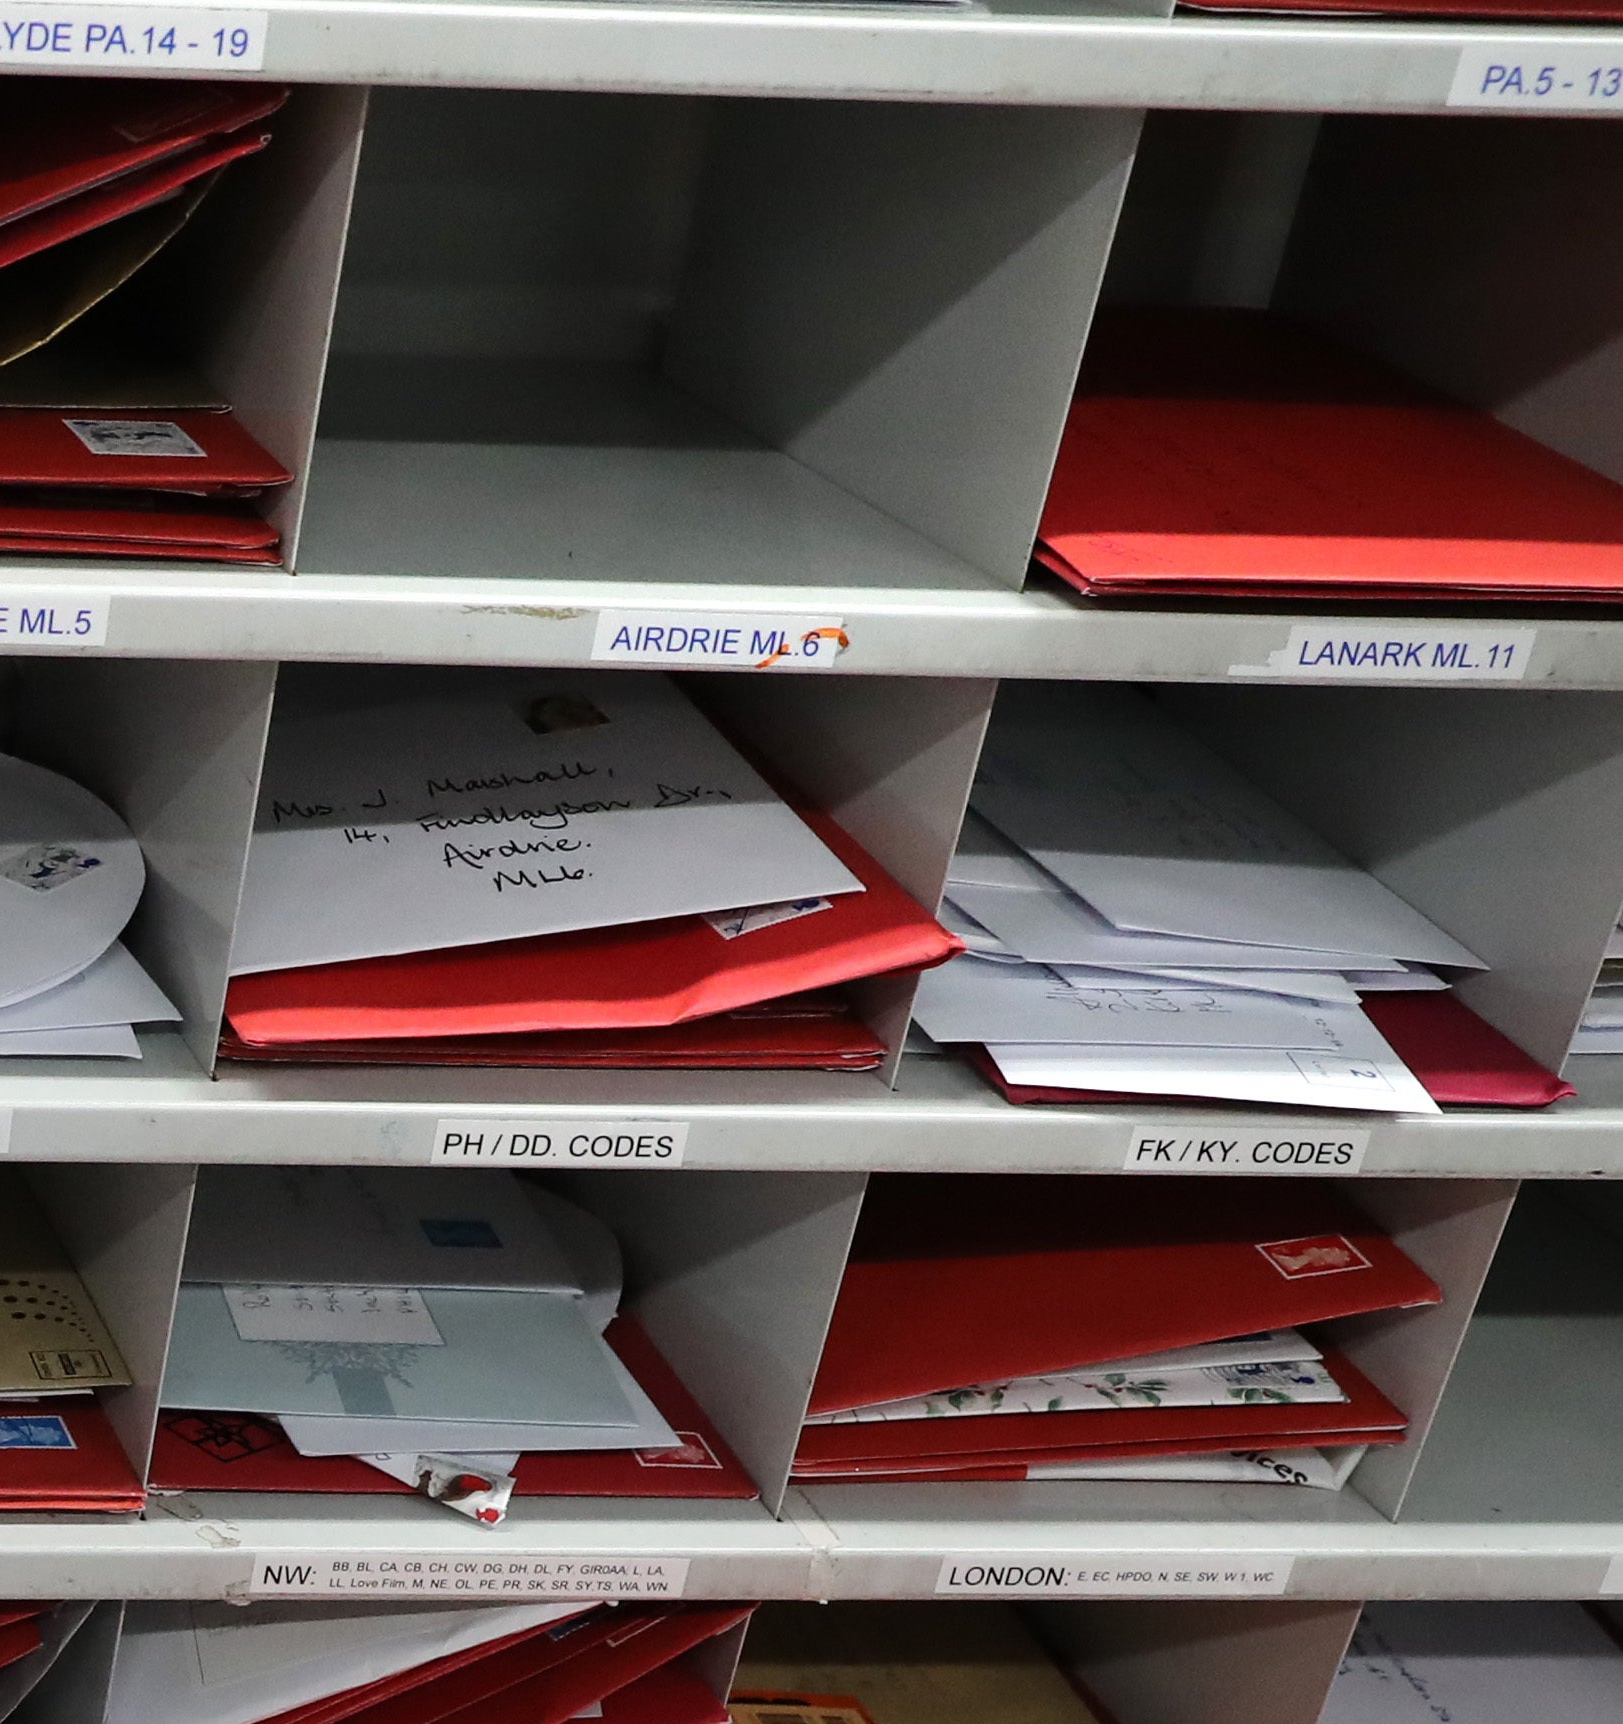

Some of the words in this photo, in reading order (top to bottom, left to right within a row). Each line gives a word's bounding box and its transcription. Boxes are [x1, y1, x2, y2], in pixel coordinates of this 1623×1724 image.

[85, 24, 176, 55] PA.14
[213, 28, 249, 58] 19
[1481, 65, 1556, 96] PA.5
[1589, 67, 1623, 97] 13
[19, 608, 91, 635] ML.5
[610, 626, 742, 654] AIRDRIE
[749, 628, 820, 657] ML.6
[1298, 640, 1426, 668] LANARK
[1430, 643, 1516, 668] ML.11
[443, 1133, 484, 1155] PH
[509, 1134, 556, 1157] DD.
[569, 1134, 674, 1158] CODES
[1136, 1139, 1176, 1162] FK
[1196, 1140, 1239, 1163] KY.
[1252, 1141, 1354, 1165] CODES
[263, 1565, 316, 1585] NW:
[949, 1566, 1071, 1586] LONDON:
